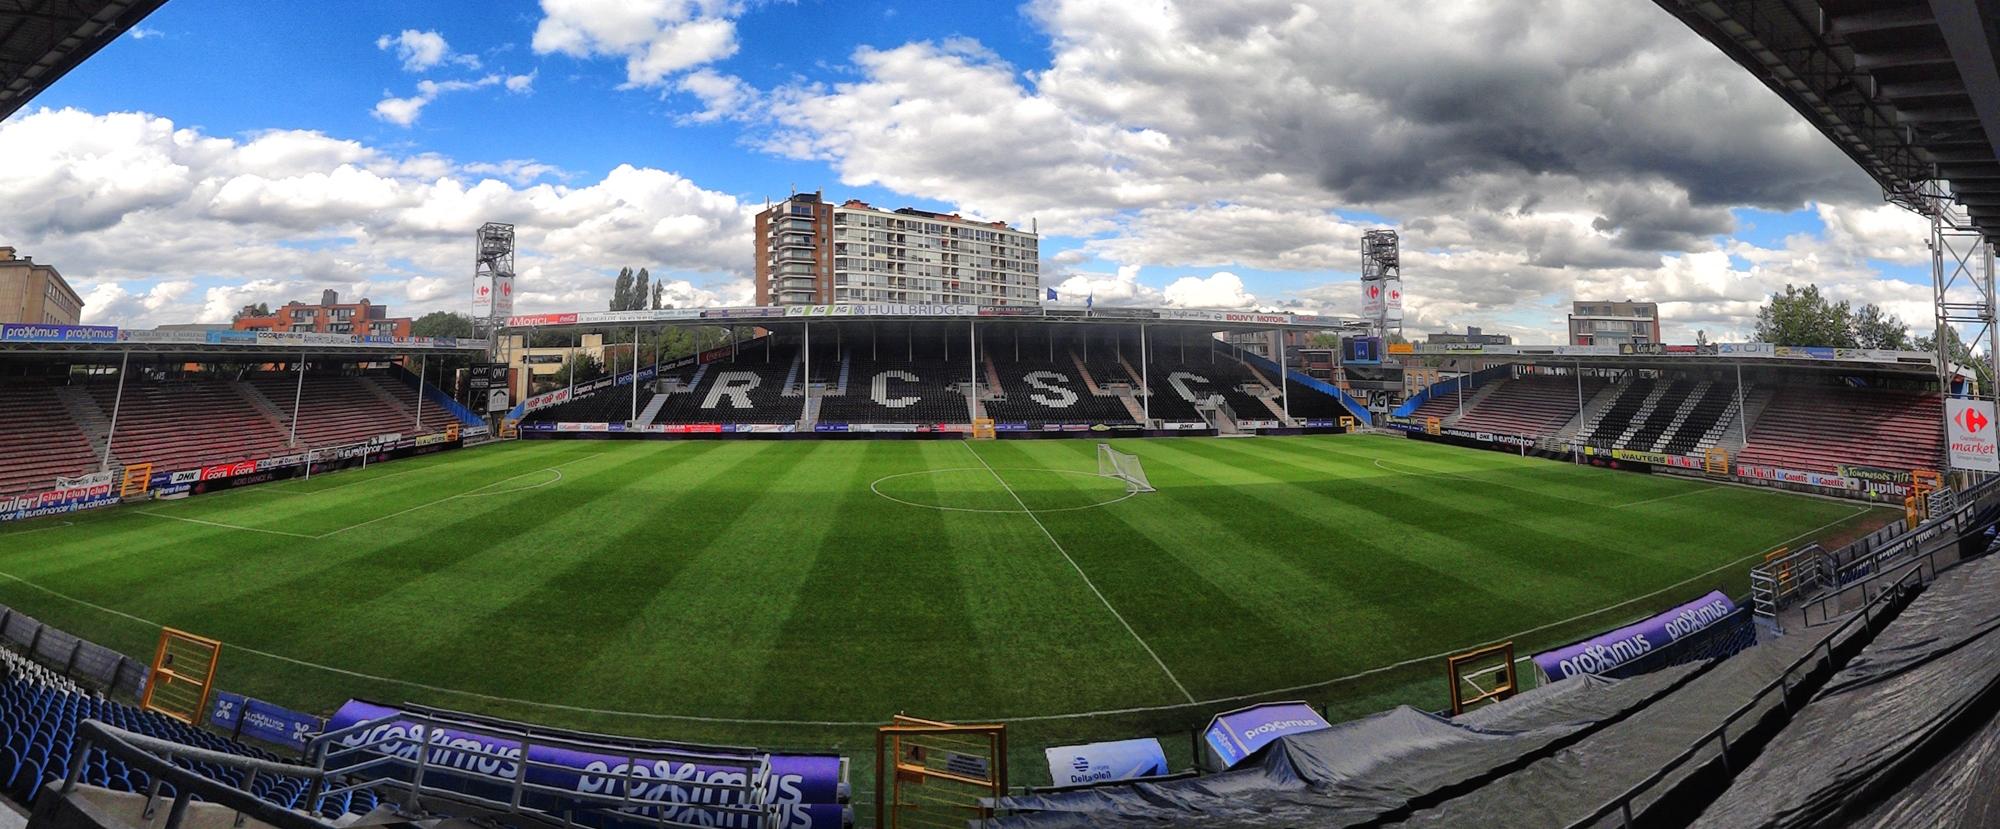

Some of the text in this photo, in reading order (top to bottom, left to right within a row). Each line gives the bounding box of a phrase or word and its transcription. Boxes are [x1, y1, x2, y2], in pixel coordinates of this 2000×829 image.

[790, 307, 803, 315] AG
[813, 306, 825, 314] AG
[836, 306, 848, 314] AG
[868, 306, 964, 315] HULLBRIDGE
[1226, 314, 1254, 322] BOUVY
[701, 371, 762, 408] R
[870, 370, 922, 408] C
[1023, 371, 1079, 408] S
[1369, 392, 1386, 407] AG
[1952, 442, 1996, 455] market
[1621, 452, 1666, 464] WAUTERS
[1863, 479, 1911, 496] Jupiler
[1664, 598, 1728, 641] proximus
[1246, 717, 1318, 740] proximus
